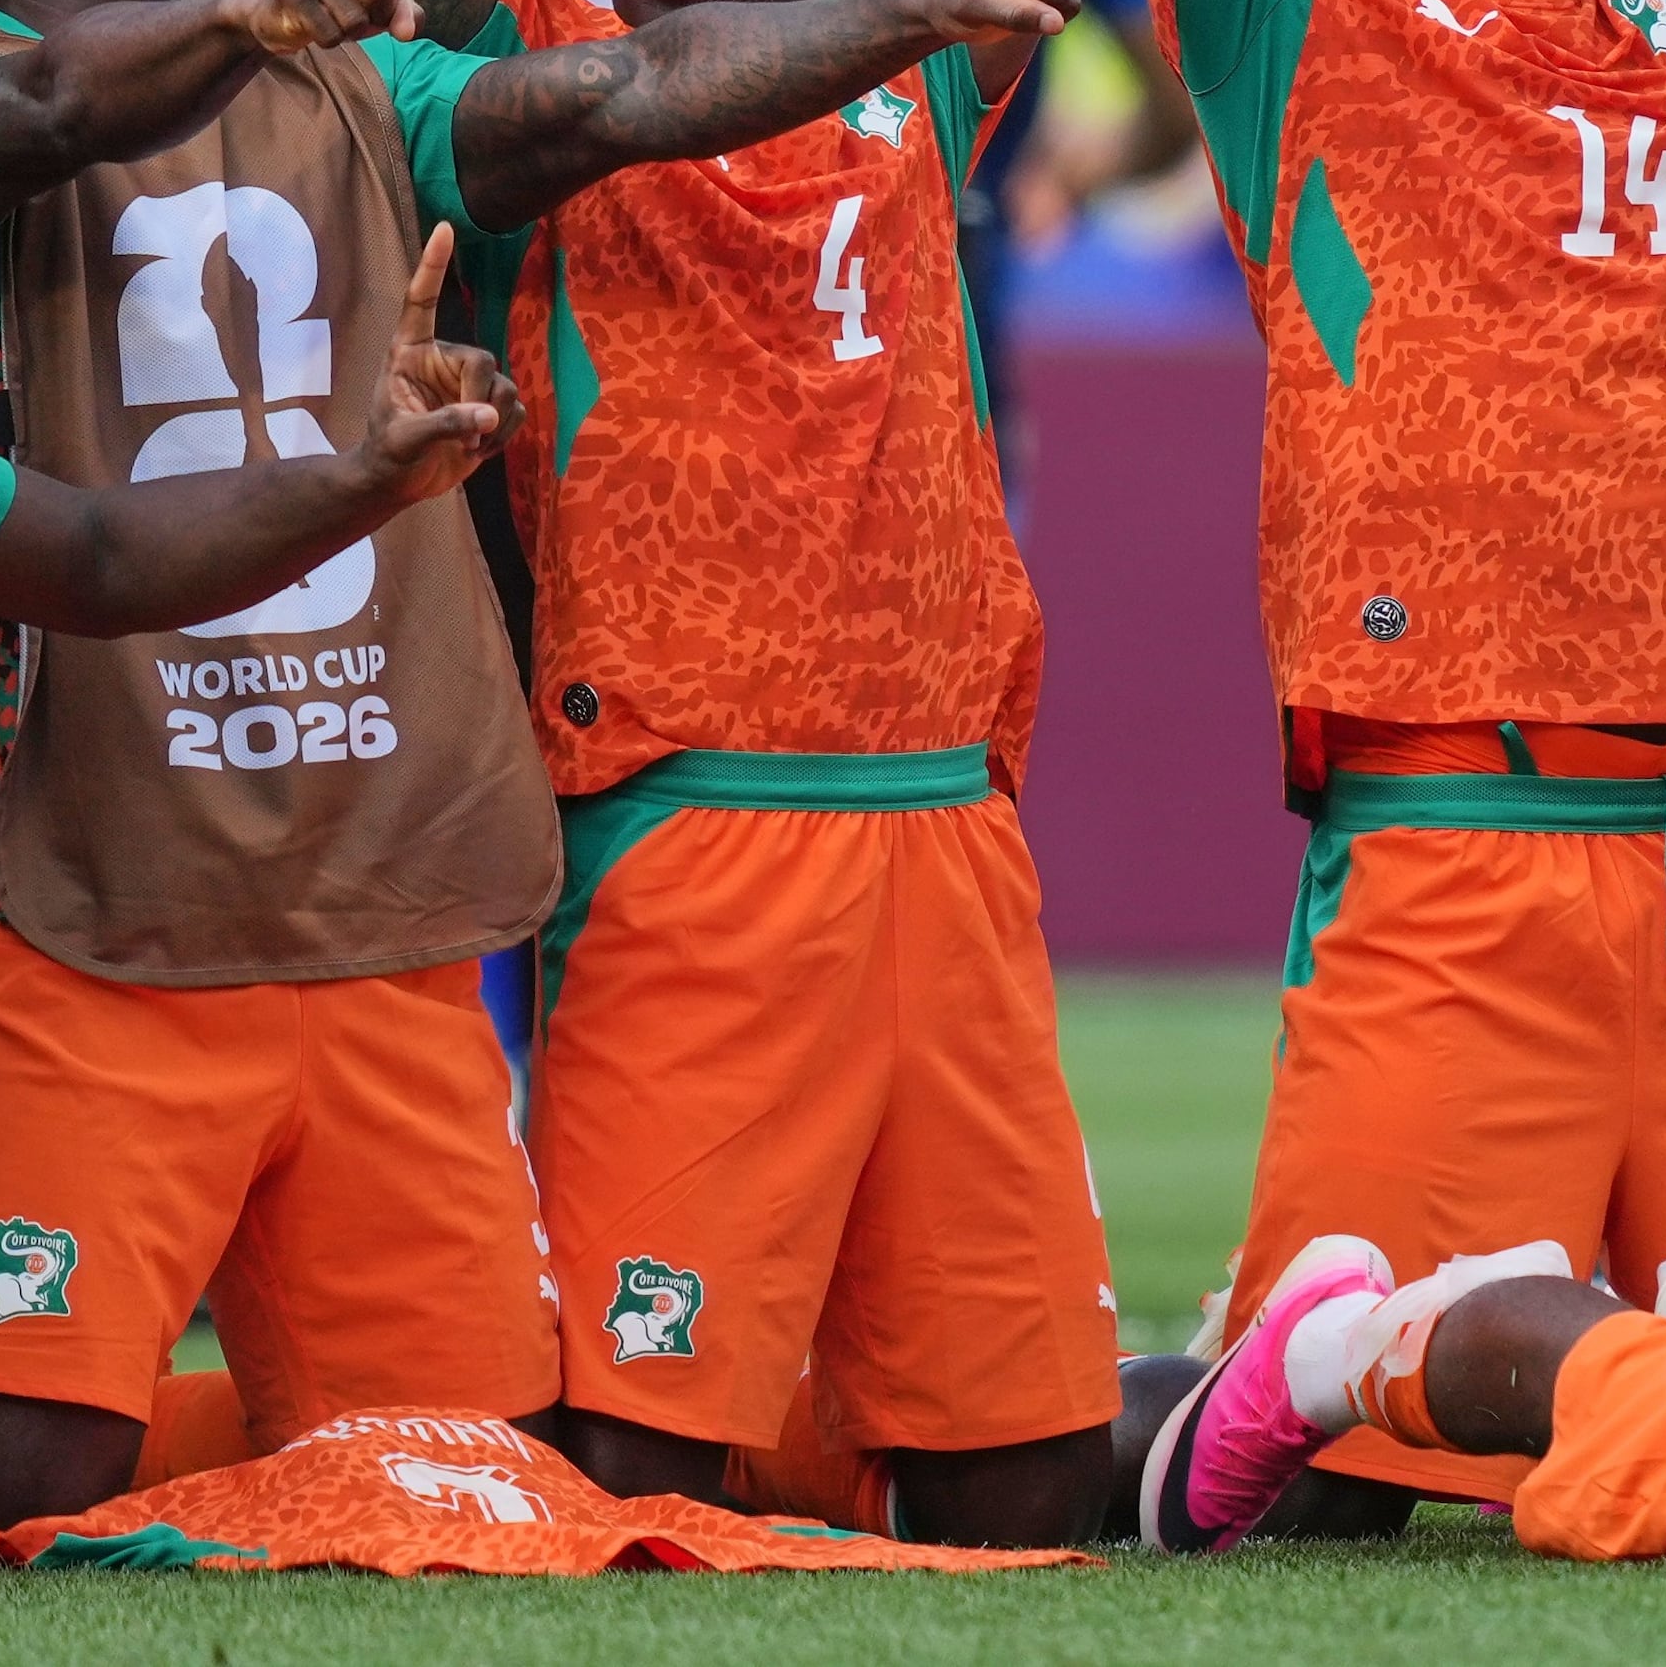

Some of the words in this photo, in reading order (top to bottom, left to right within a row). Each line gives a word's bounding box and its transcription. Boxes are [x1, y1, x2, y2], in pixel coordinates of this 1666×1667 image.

[812, 194, 885, 363] 4
[155, 652, 309, 700] WORLD
[312, 642, 387, 687] CUP
[166, 694, 399, 772] 2026
